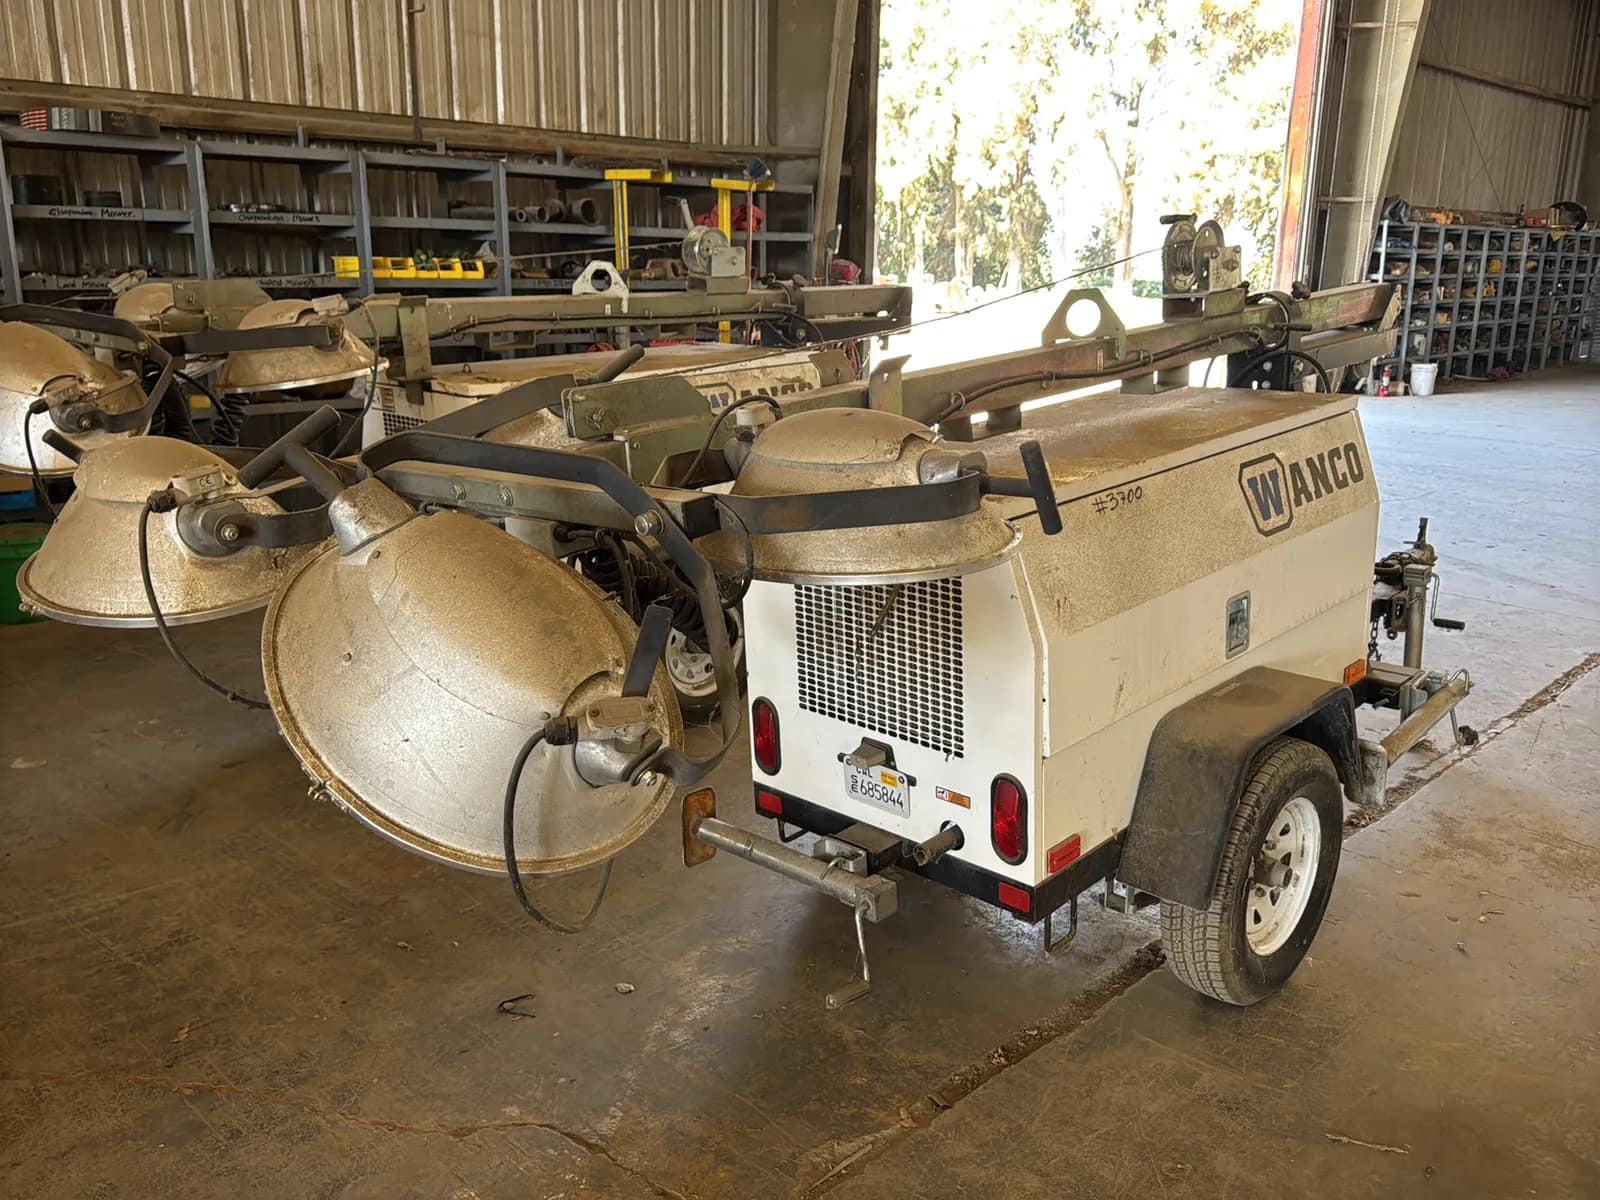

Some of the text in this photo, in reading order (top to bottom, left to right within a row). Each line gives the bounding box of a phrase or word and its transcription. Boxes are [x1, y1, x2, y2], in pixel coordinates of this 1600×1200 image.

[1246, 441, 1365, 522] WANCO
[1092, 486, 1143, 515] #3700
[860, 779, 905, 812] 685844
